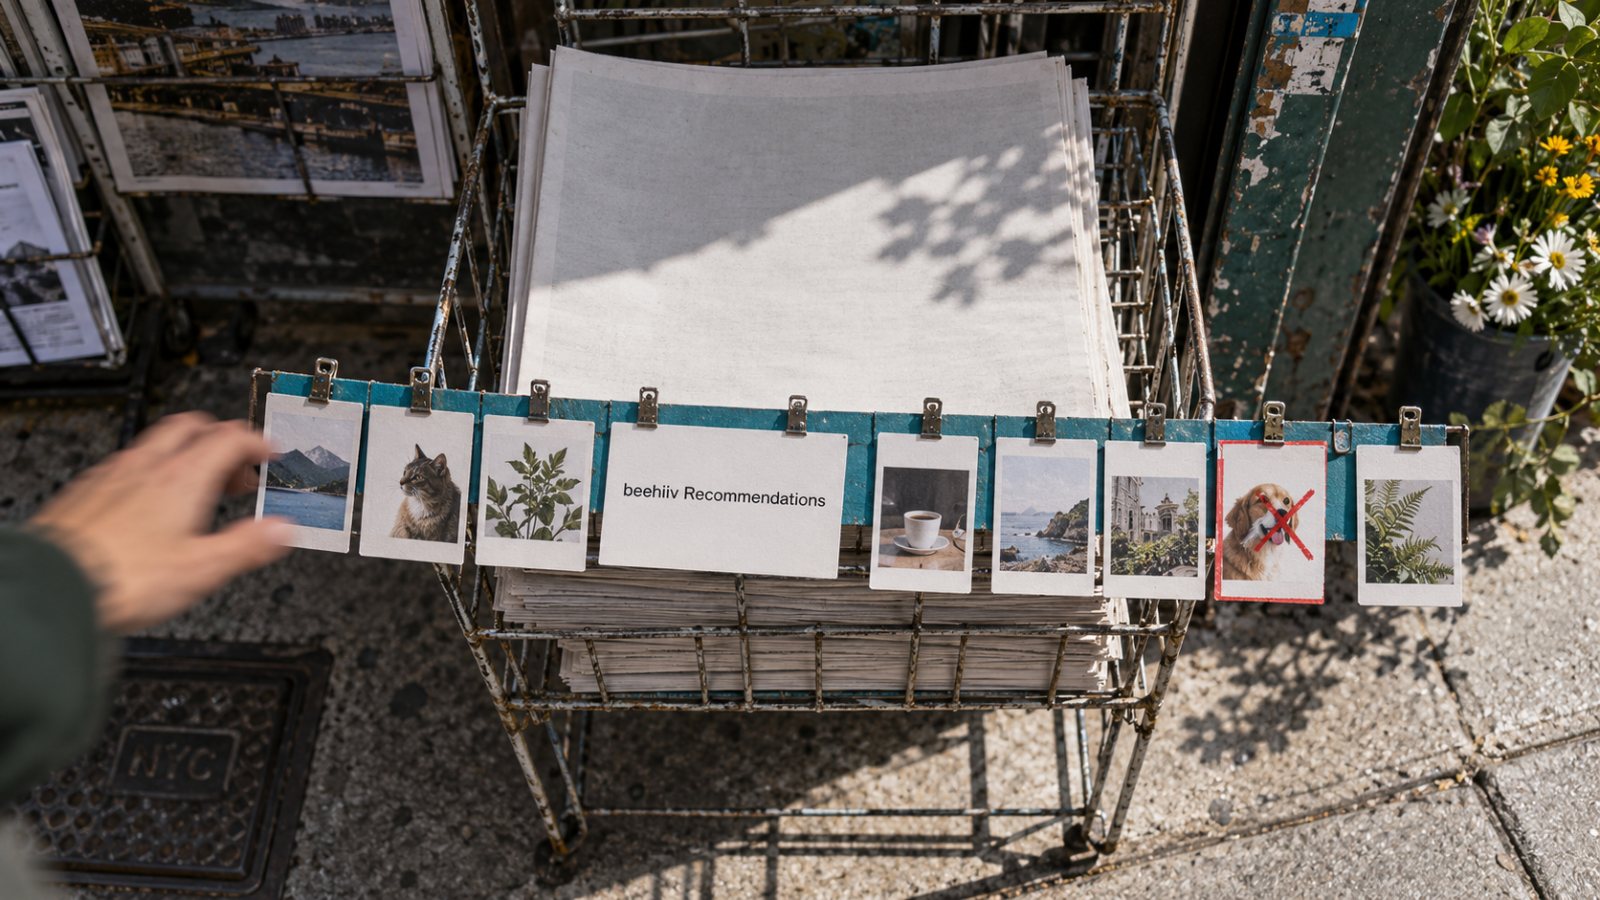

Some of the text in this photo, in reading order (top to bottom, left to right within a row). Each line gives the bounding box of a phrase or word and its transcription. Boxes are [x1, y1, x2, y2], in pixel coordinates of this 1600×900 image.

[623, 483, 826, 507] beehiiv Recommendations
[128, 745, 217, 780] NYC
